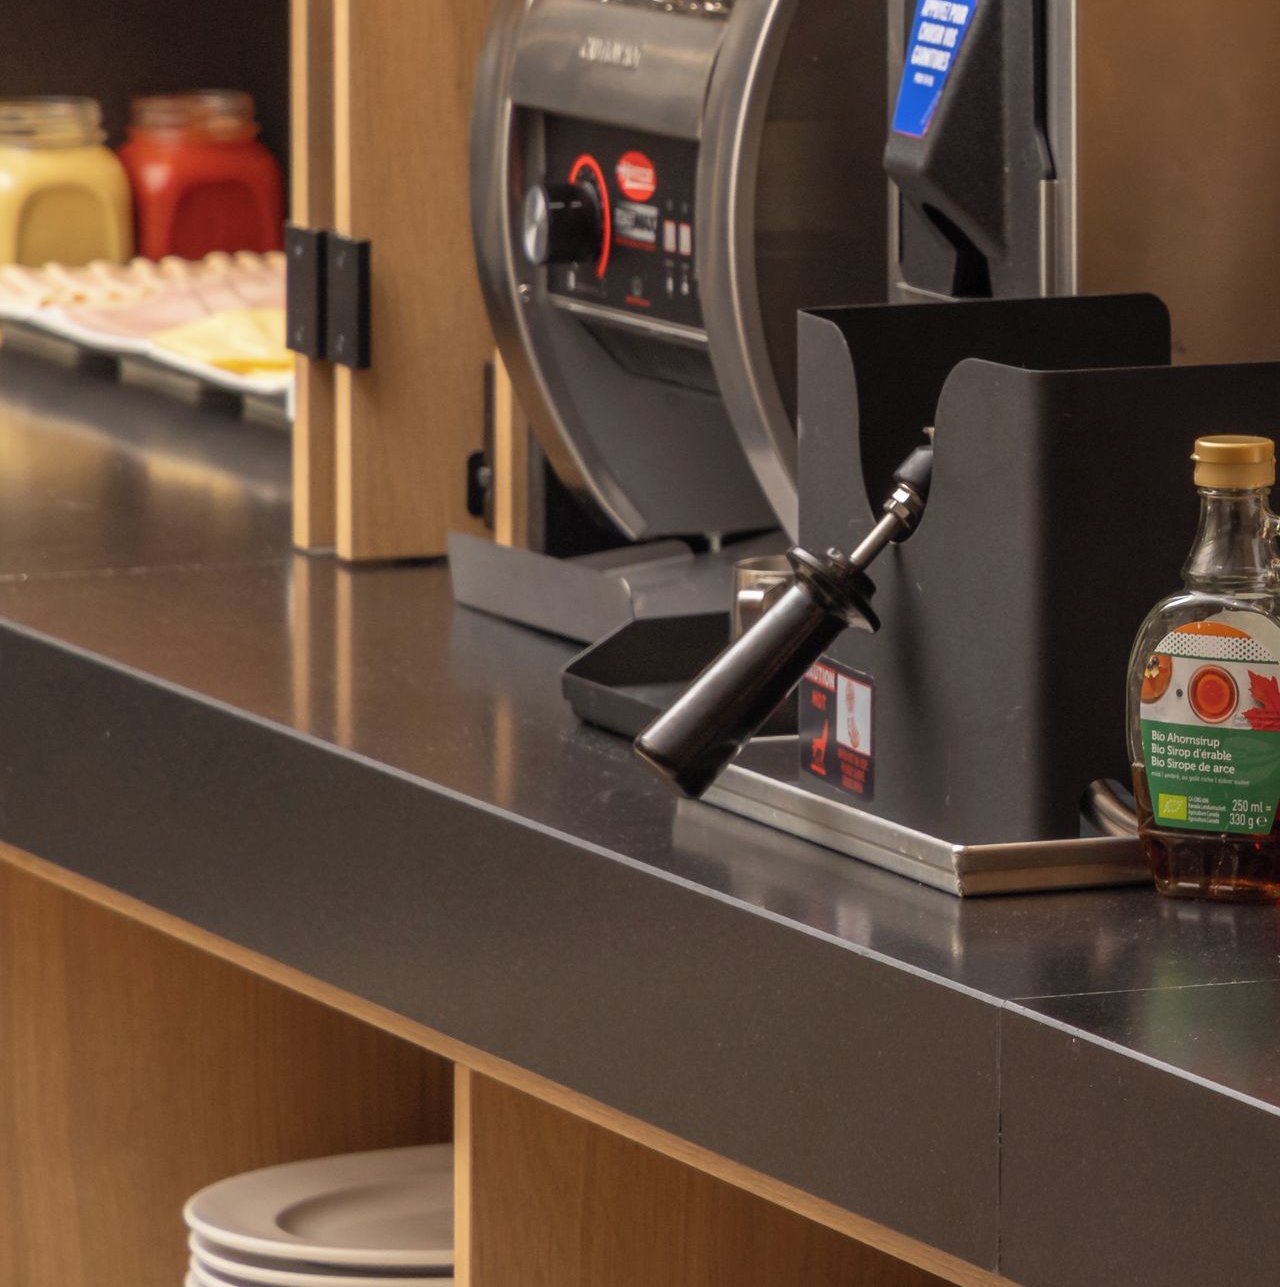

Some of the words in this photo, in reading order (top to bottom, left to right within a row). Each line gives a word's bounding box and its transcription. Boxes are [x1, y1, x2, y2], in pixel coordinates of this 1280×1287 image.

[1151, 730, 1166, 742] Bio
[1167, 732, 1220, 749] Ahornsirup
[1151, 743, 1165, 755] Bio
[1167, 745, 1191, 759] Sirop
[1193, 748, 1232, 761] d'érable
[1151, 756, 1165, 768] Bio
[1167, 758, 1196, 772] Sirope
[1198, 761, 1211, 772] de
[1213, 765, 1235, 775] arce
[1232, 799, 1249, 812] 250
[1250, 801, 1263, 813] ml
[1229, 813, 1246, 826] 330
[1248, 817, 1254, 829] g
